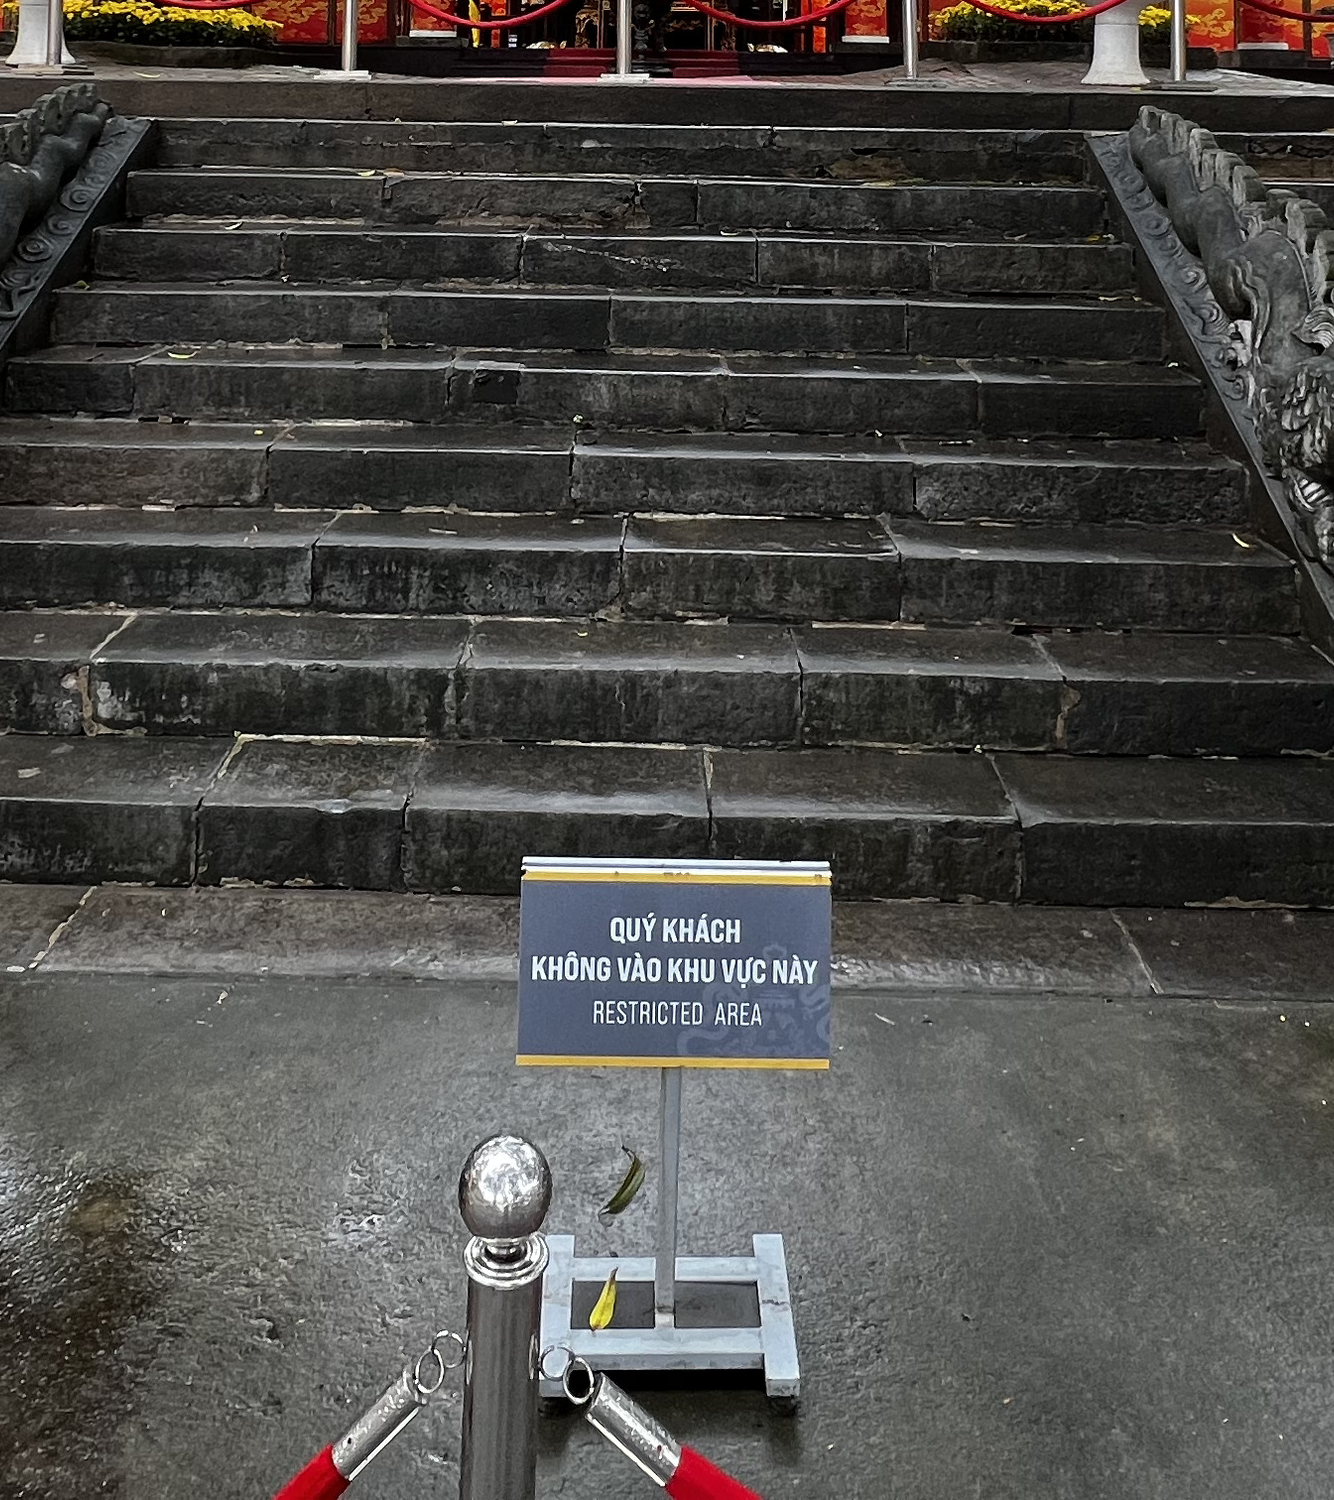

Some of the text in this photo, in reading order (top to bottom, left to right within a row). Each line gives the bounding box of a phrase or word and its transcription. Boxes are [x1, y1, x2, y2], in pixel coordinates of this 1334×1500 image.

[609, 912, 741, 945] QUÝ KHÁCH
[531, 951, 818, 989] KHÔNG VÀO KHU VỰC NÀY
[593, 1000, 763, 1027] RESTRICTED AREA
